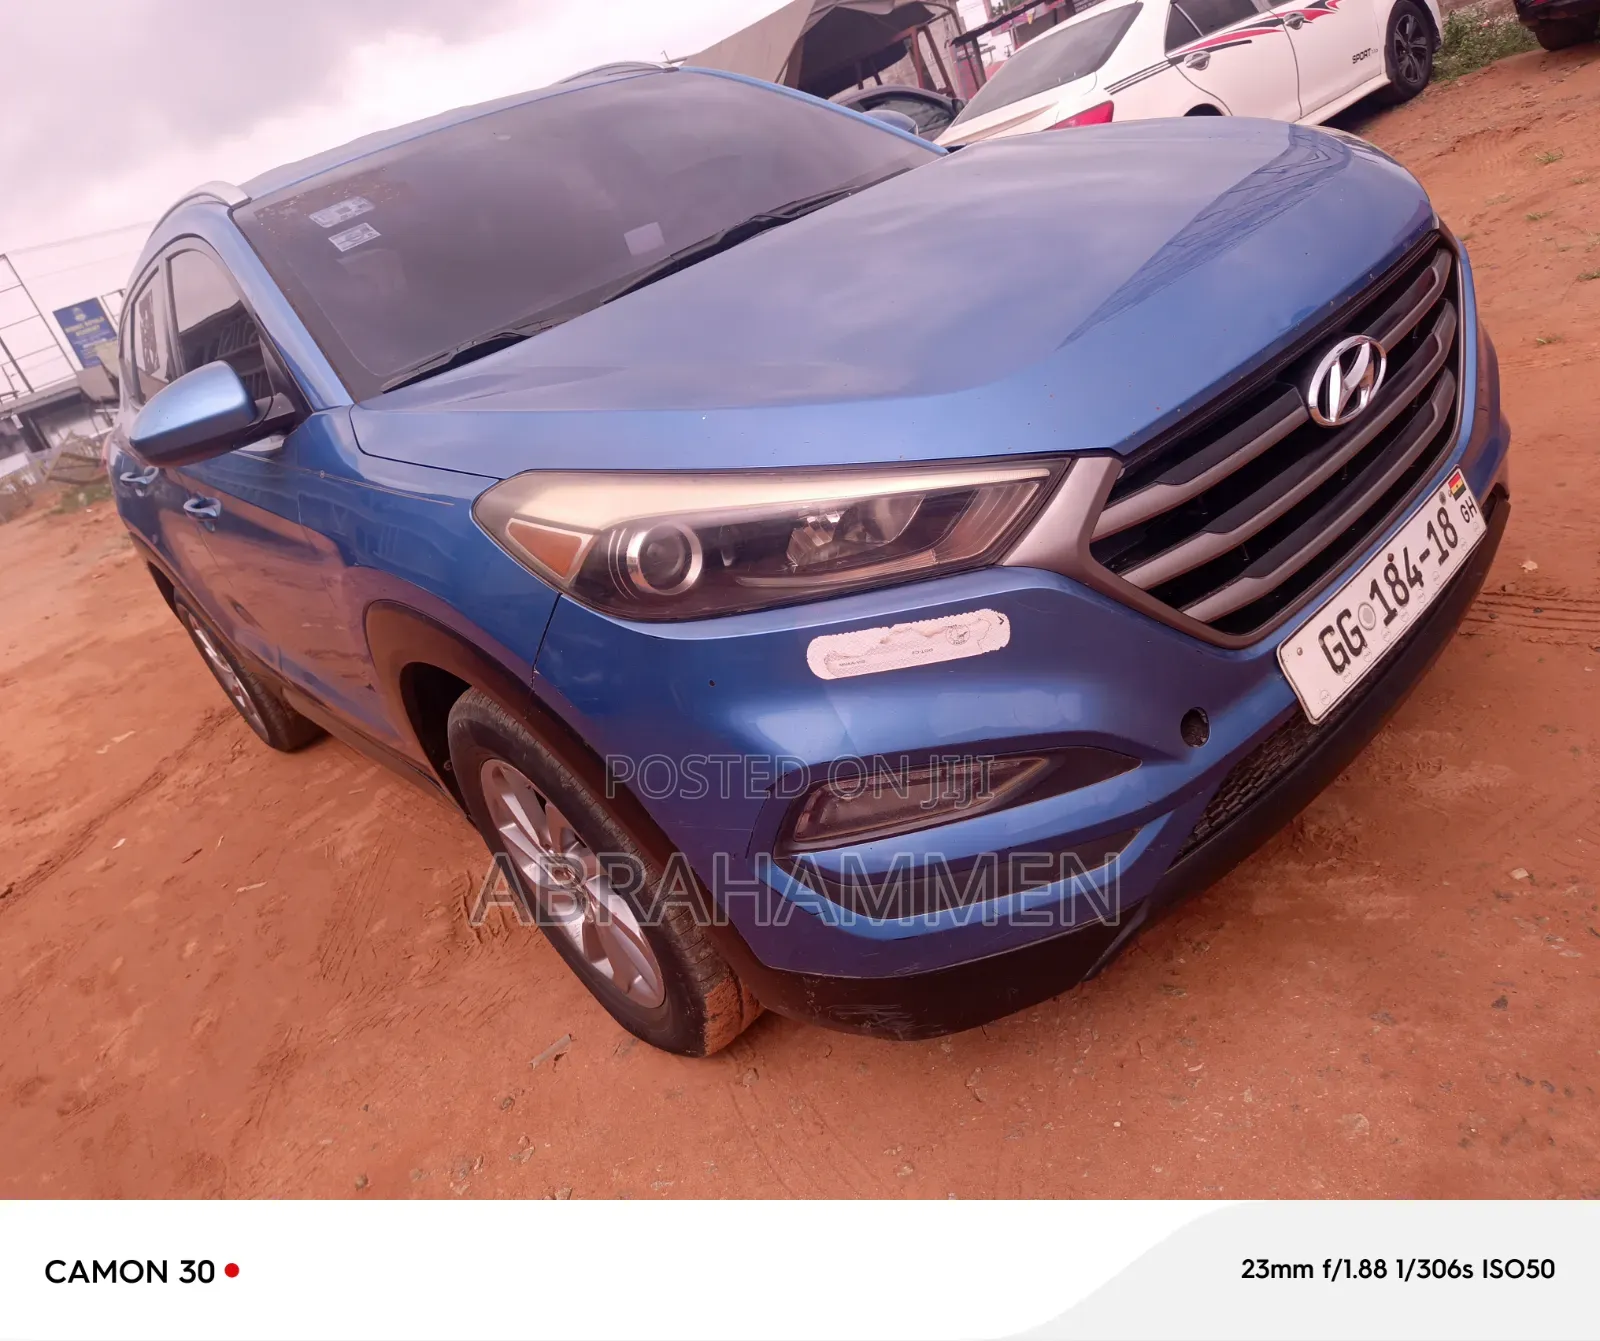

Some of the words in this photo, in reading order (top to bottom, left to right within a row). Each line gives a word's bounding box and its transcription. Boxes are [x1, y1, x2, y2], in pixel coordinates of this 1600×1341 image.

[1352, 47, 1372, 64] SPORT
[1459, 498, 1478, 525] GH
[1317, 607, 1368, 675] GG
[1369, 506, 1459, 627] 184-18
